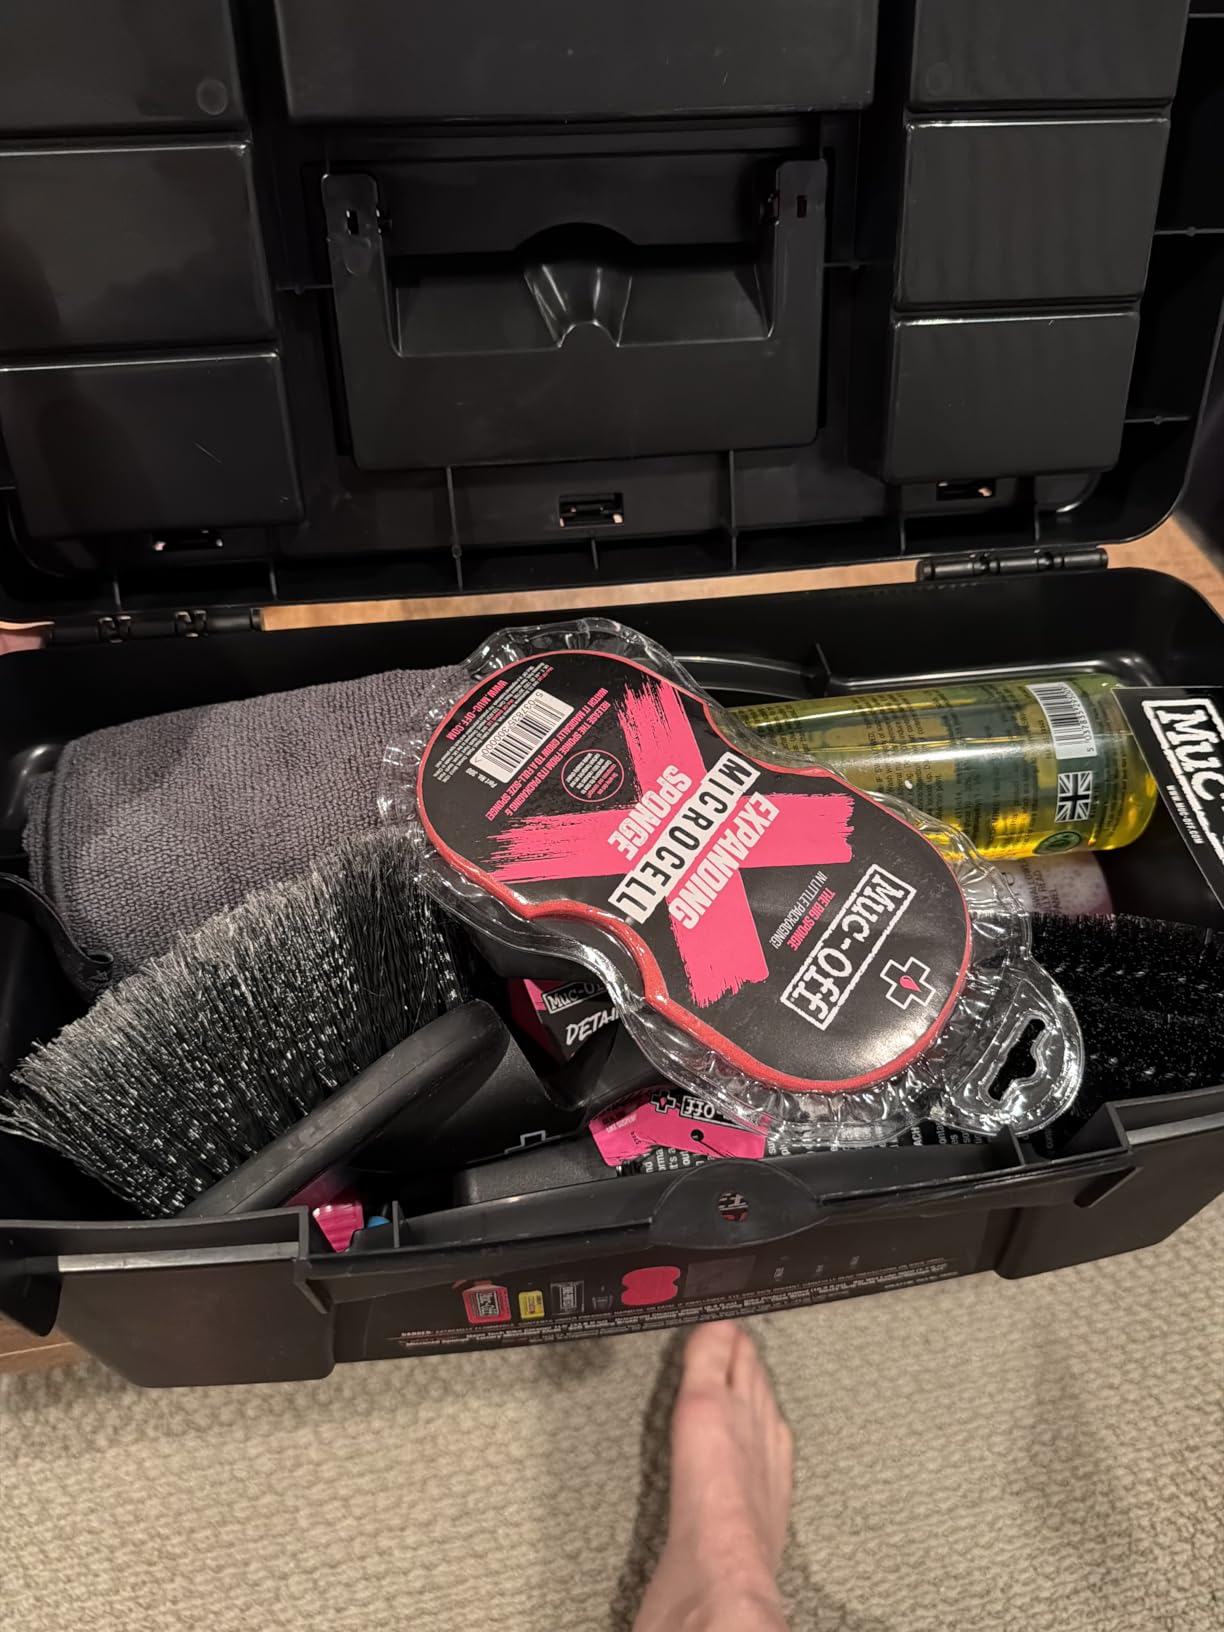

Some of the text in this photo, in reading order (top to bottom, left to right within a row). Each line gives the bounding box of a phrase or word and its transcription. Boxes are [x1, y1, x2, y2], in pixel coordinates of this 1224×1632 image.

[445, 678, 507, 743] WWW.MUC-OFF.COM
[507, 698, 536, 728] 037835
[535, 690, 543, 699] 5
[586, 700, 611, 725] RELEASE
[480, 725, 510, 757] 300000
[559, 732, 582, 756] SPONGE
[577, 722, 591, 735] THE
[485, 686, 608, 822] WATCH IT MAGICALLY GROW TO A FULL-SIZE SPONGE!
[537, 768, 550, 780] ITS
[545, 752, 564, 771] FROM
[1156, 708, 1224, 808] Muc
[509, 777, 542, 812] PACKAGING
[606, 763, 693, 861] SPONGE
[1166, 784, 1205, 845] WWW.MUC-OFF.COM
[615, 757, 753, 913] MICROCELL
[665, 791, 781, 932] EXPANDING
[768, 871, 827, 949] IN LITTLE PACKAGING!
[785, 886, 836, 951] THE BIG SPONGE
[788, 871, 905, 1023] Muc-Off
[912, 1125, 922, 1147] ACH
